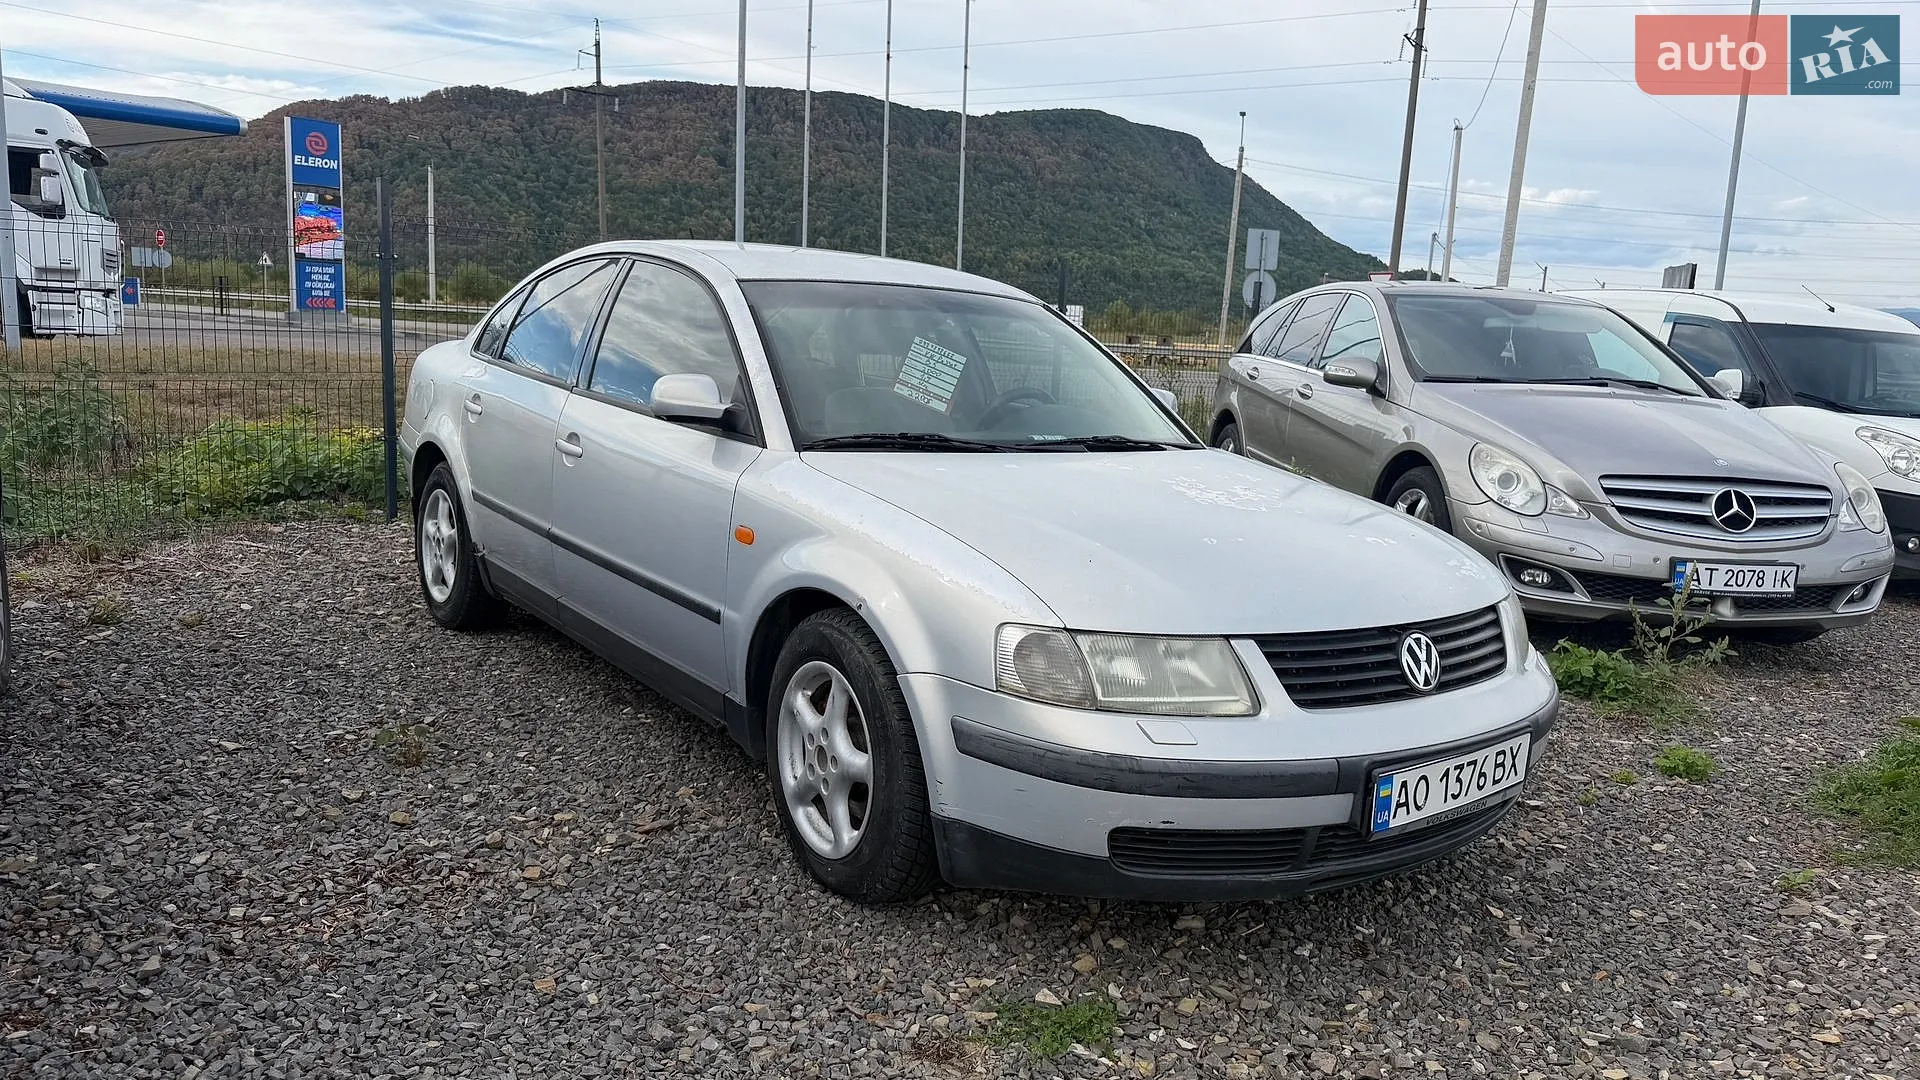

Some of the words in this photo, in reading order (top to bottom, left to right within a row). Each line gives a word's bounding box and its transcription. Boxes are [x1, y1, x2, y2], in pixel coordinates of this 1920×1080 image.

[294, 154, 338, 170] ELERON
[1690, 567, 1719, 587] AT
[1723, 569, 1766, 588] 2078
[1772, 569, 1794, 589] IK
[1392, 774, 1430, 820] AO
[1439, 754, 1490, 804] 1376
[1491, 742, 1523, 786] BX
[1377, 811, 1389, 824] UA
[1425, 800, 1488, 826] VOLKSWAGEN
